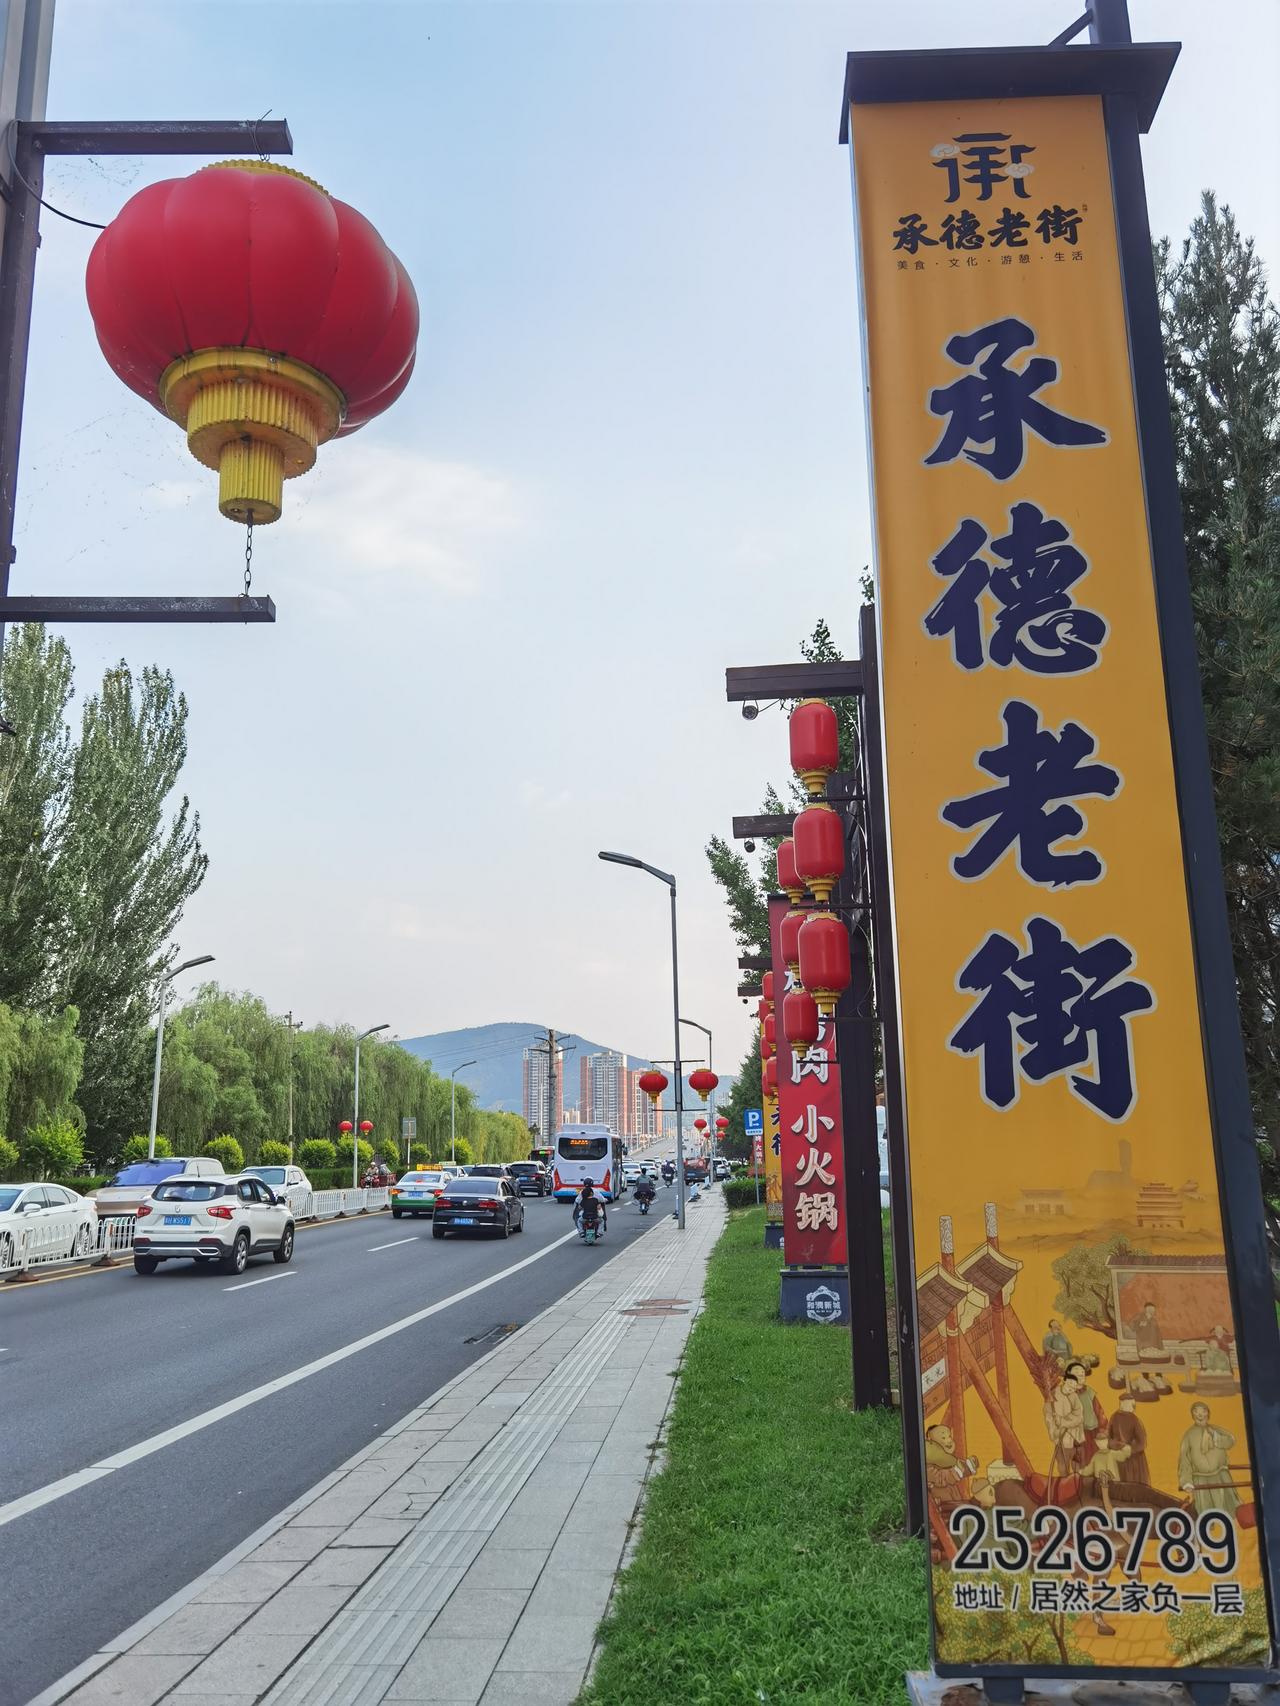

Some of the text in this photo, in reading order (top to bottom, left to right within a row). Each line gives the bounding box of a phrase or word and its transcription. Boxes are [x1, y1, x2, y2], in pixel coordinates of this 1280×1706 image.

[892, 204, 1083, 254] 承德老街
[922, 317, 1154, 1122] 承德老街
[950, 1507, 1237, 1574] 2526789
